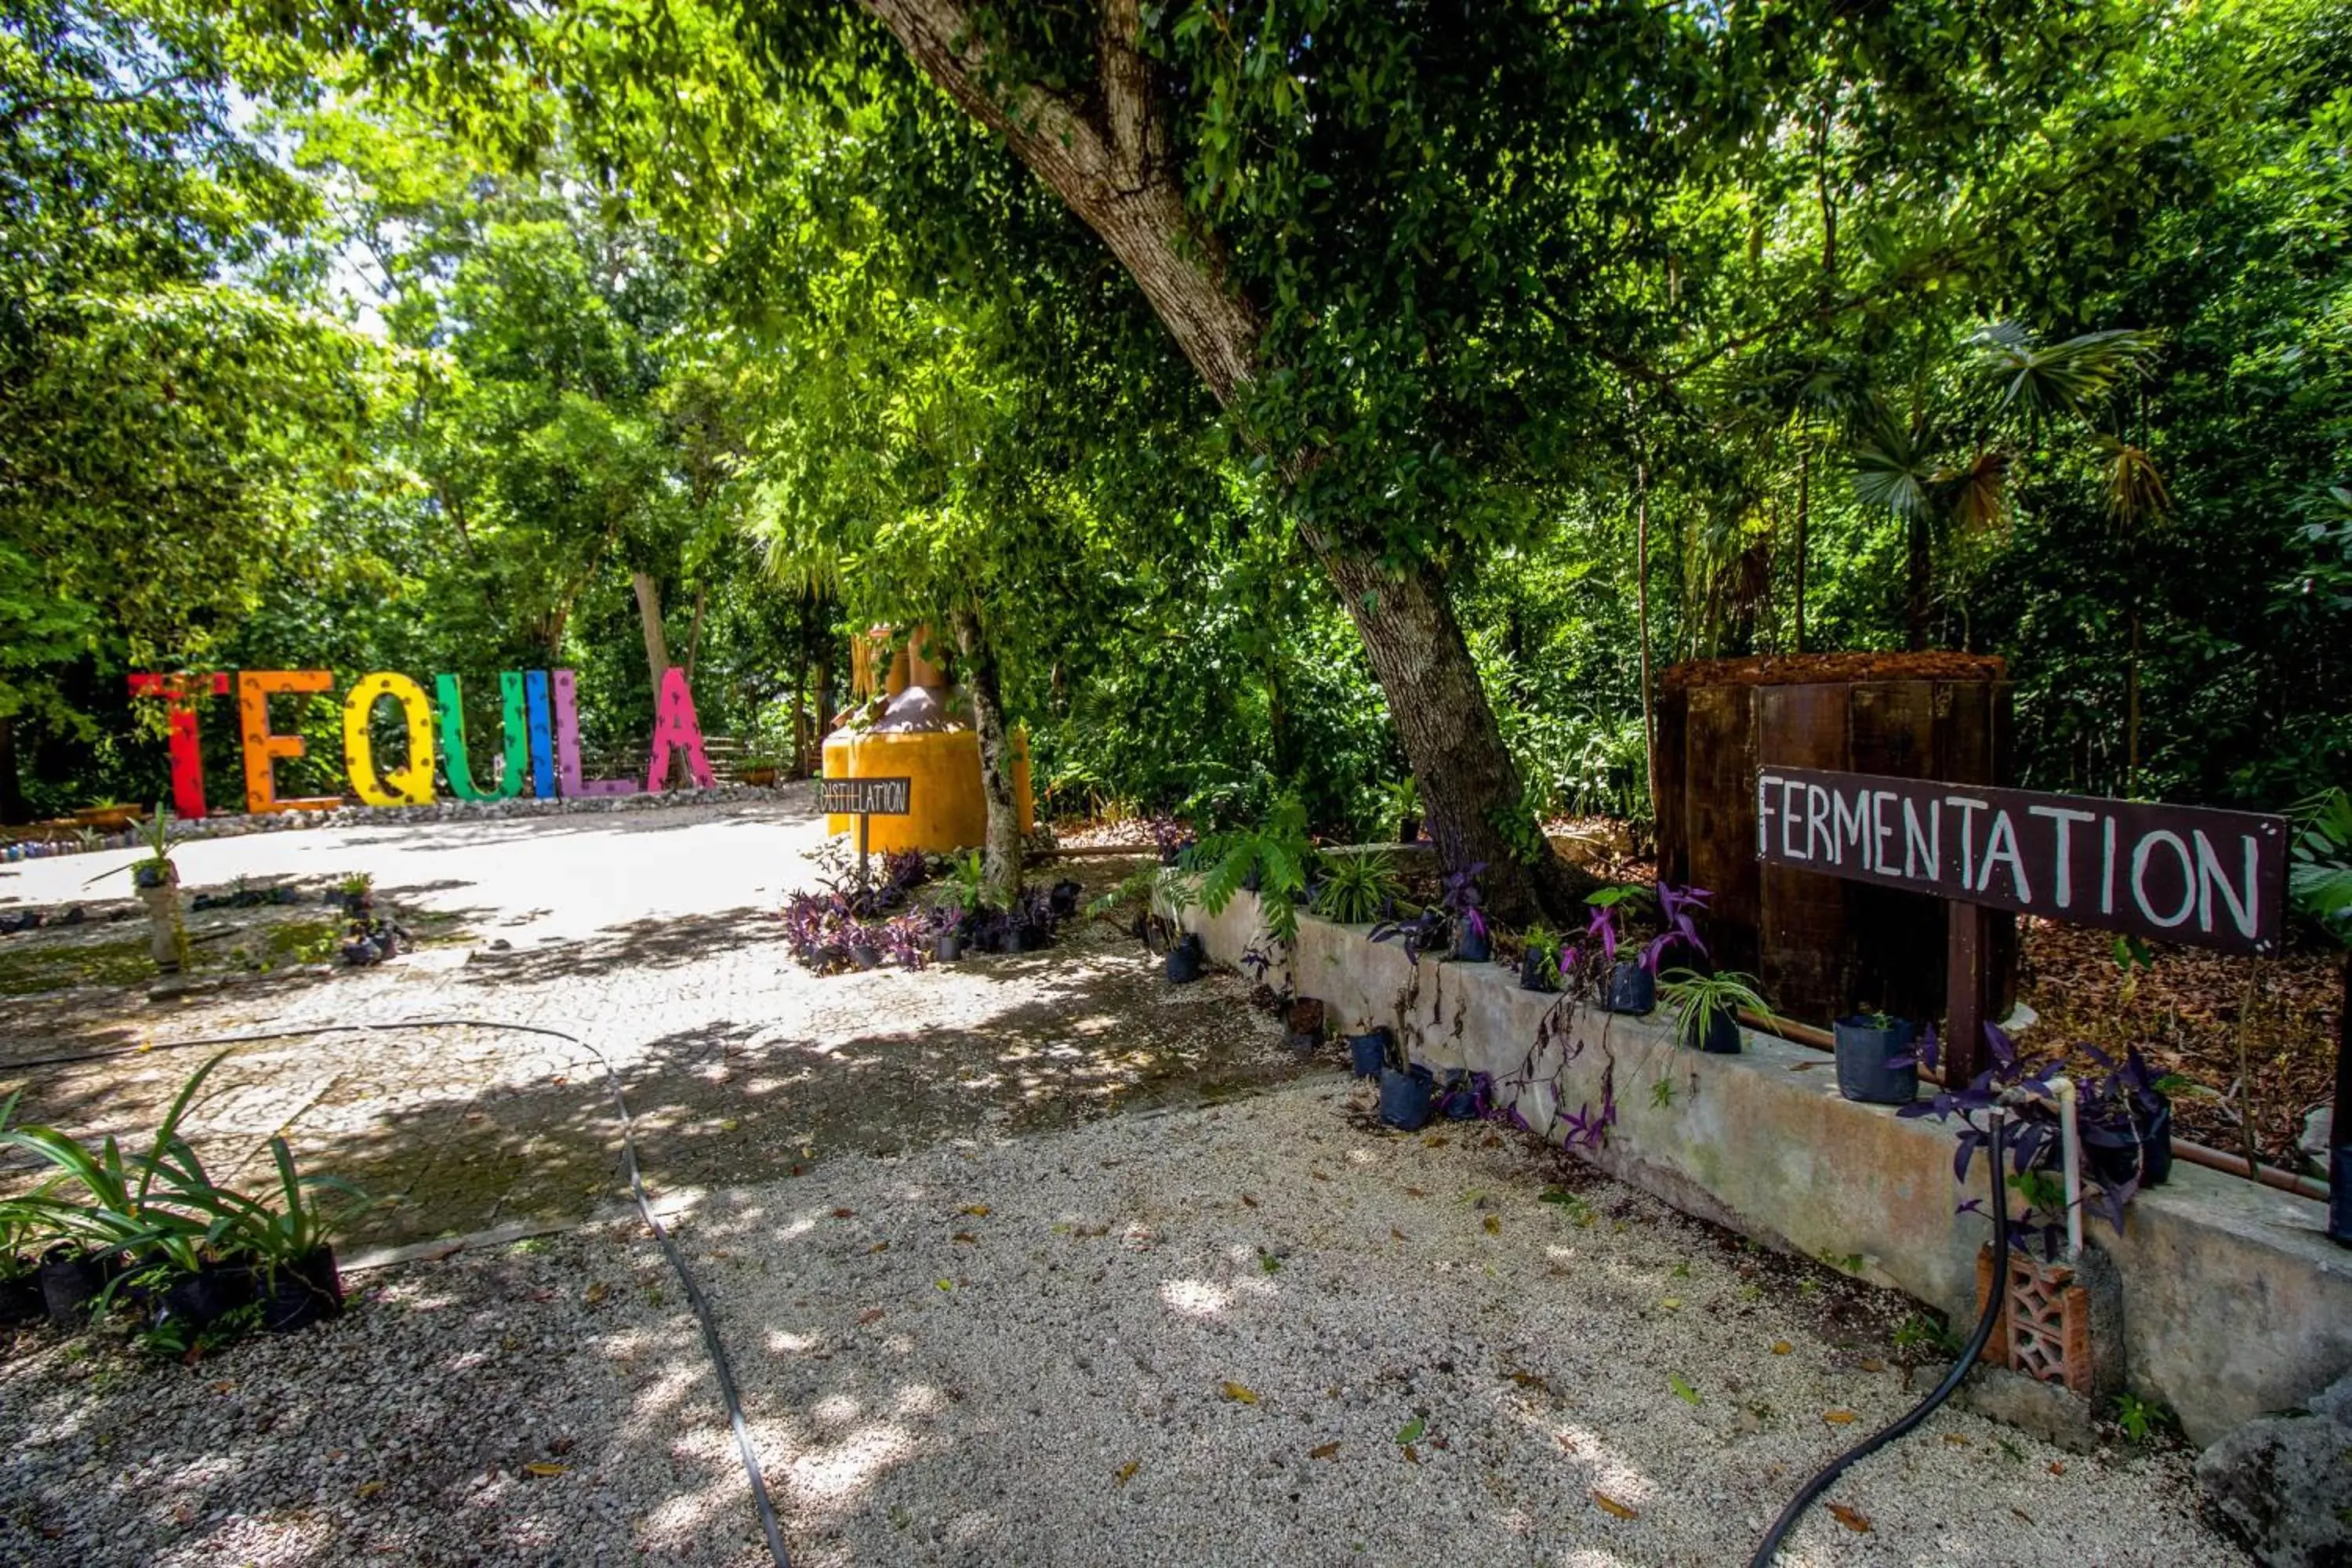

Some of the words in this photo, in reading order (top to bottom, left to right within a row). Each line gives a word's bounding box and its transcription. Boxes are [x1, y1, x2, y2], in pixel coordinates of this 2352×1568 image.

[127, 667, 716, 818] TEQUILA
[821, 782, 906, 812] DISTILLATION
[1759, 777, 2258, 938] FERMENTATION
